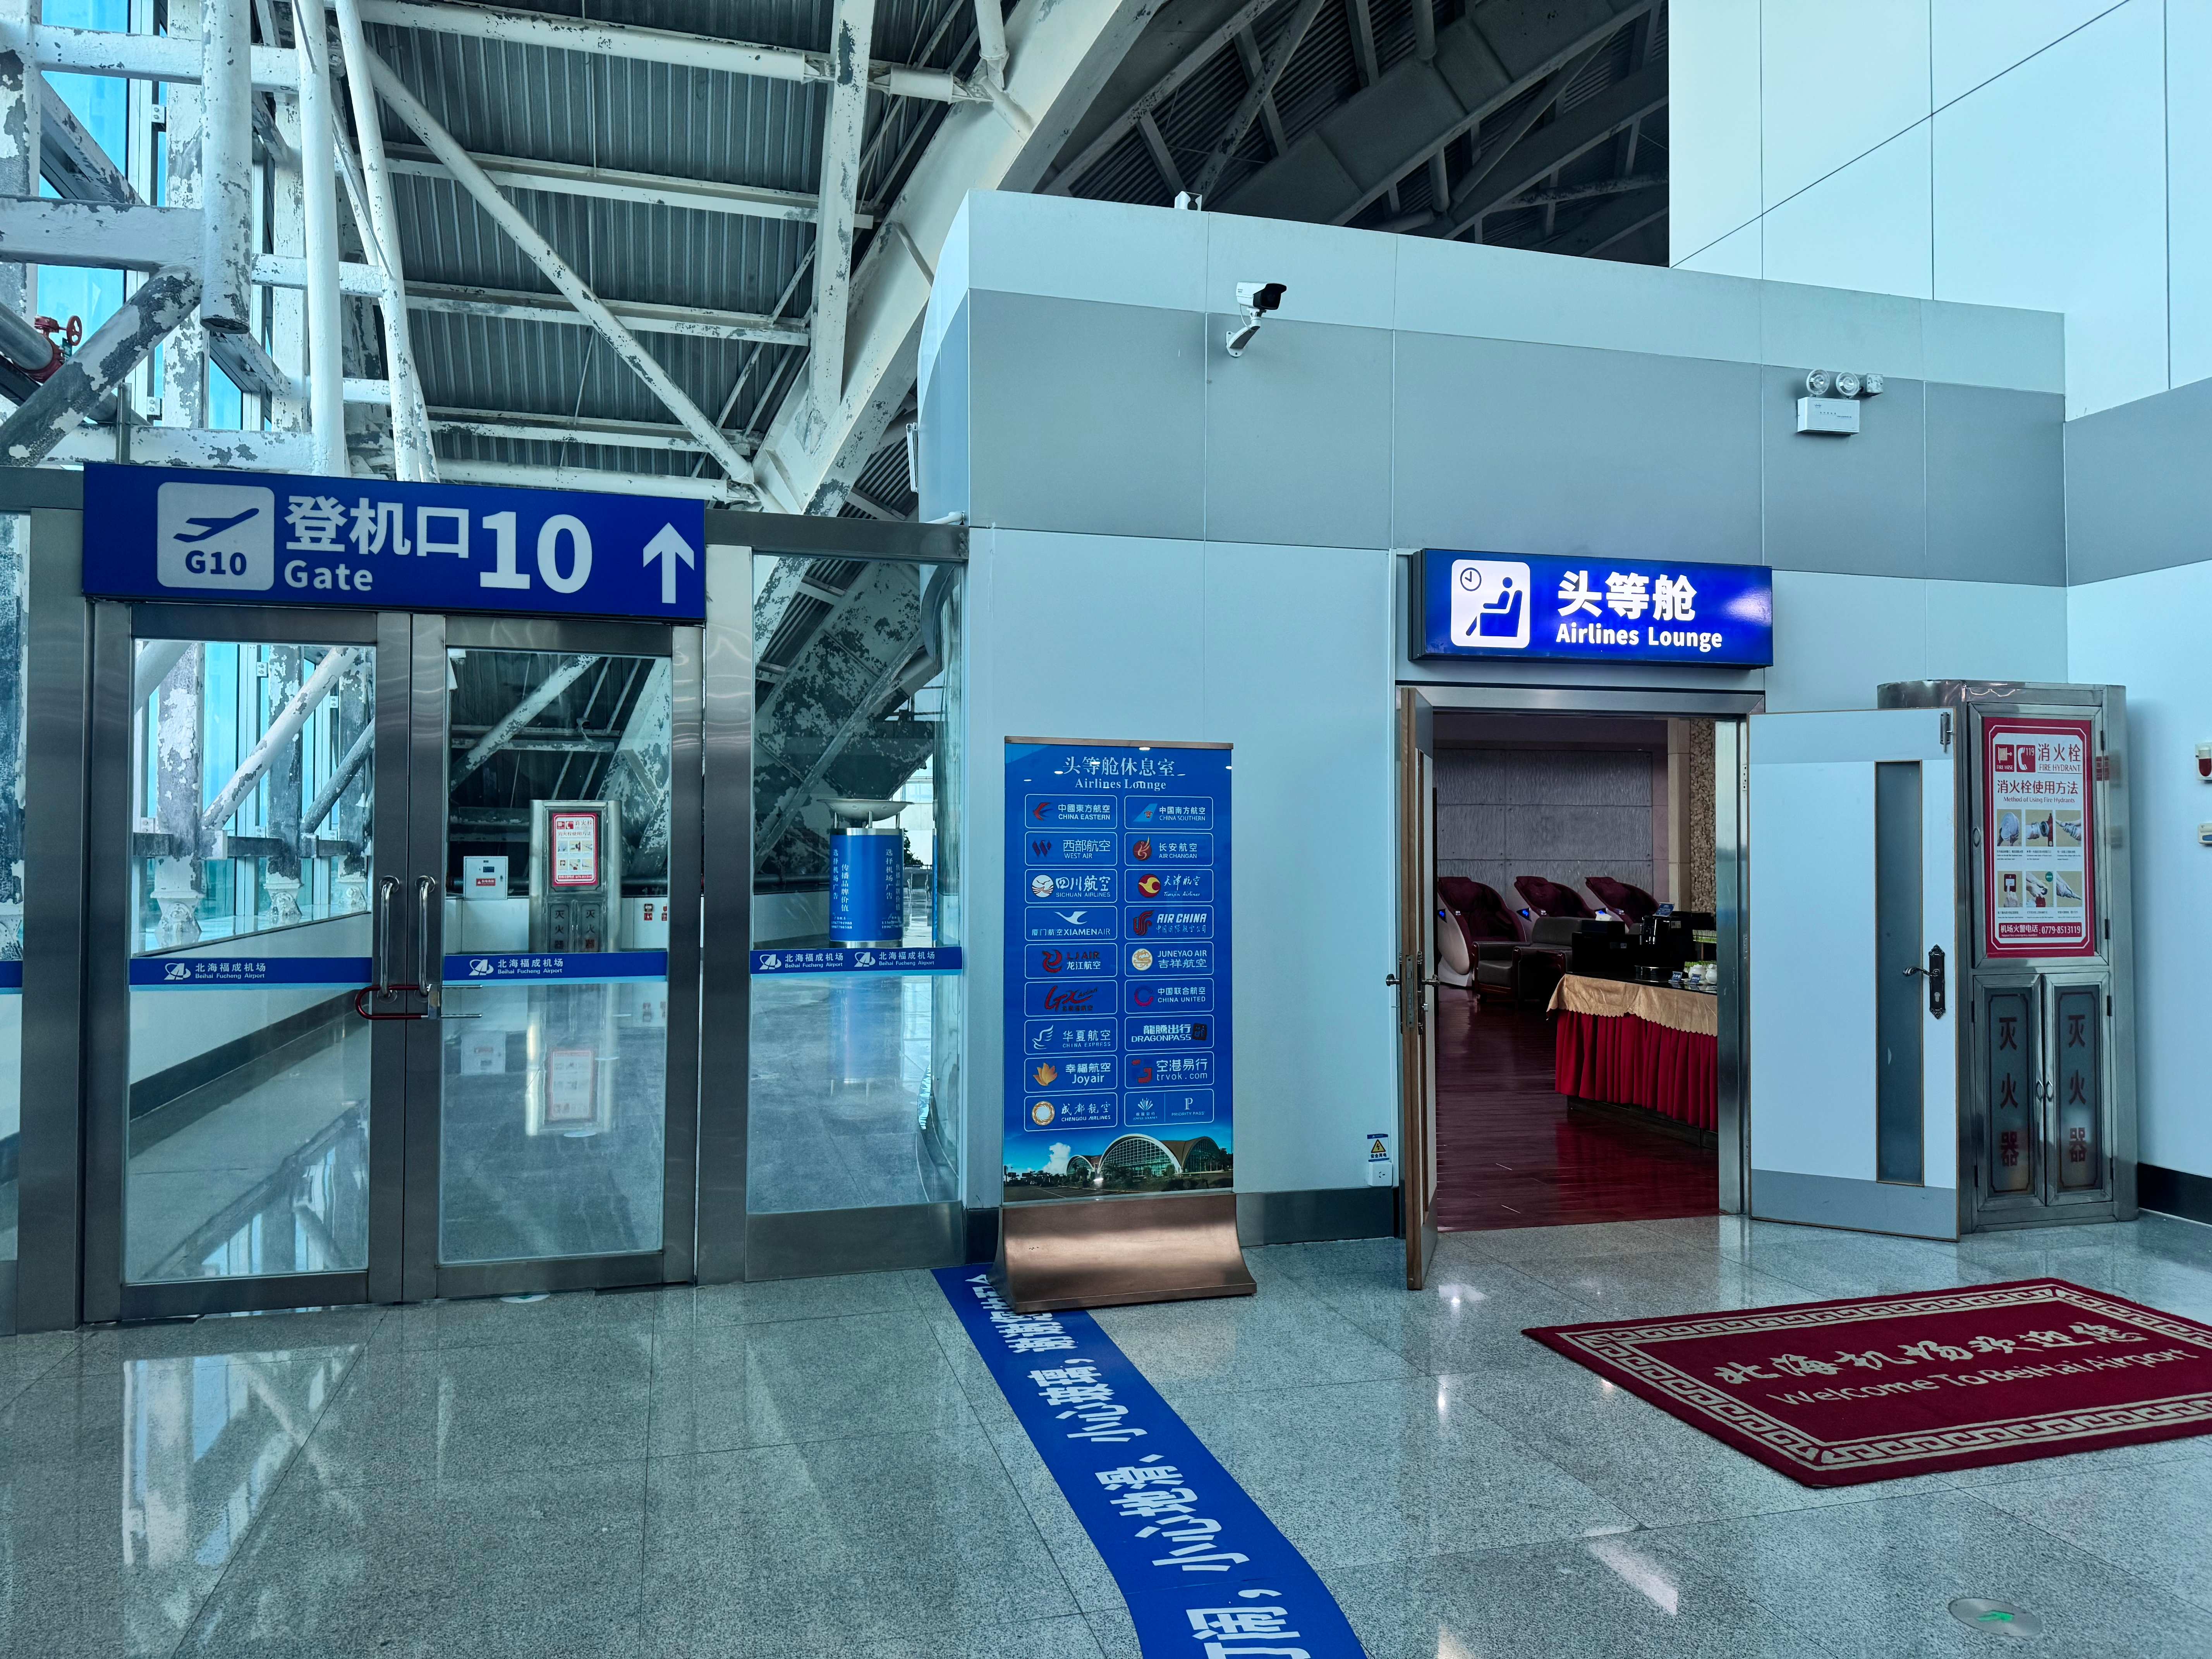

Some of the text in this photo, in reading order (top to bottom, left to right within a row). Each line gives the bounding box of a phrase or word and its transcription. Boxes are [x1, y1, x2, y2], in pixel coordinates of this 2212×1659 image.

[285, 495, 592, 594] 登机口 10
[185, 550, 247, 575] G10
[284, 560, 373, 591] Gate
[1557, 570, 1697, 621] 头等舱
[1556, 623, 1723, 652] Airlines Lounge
[2026, 747, 2034, 756] 119
[2038, 743, 2081, 762] 消火栓
[1063, 756, 1175, 776] 头等舱休息室
[1075, 778, 1166, 791] Airlines Lounge
[1997, 780, 2078, 794] 消火栓使用方法
[1159, 806, 1206, 815] 中国南方航空
[1063, 840, 1111, 852] 西部航空
[1159, 843, 1197, 852] 长安航空
[1056, 875, 1111, 892] 四川航空
[1164, 874, 1200, 891] 天津航空
[1157, 913, 1207, 923] AIR CHINA
[785, 953, 844, 963] 北海福成机场
[879, 951, 935, 960] 北海福成机场
[195, 962, 266, 972] 北海福成机场
[498, 958, 563, 968] 北海福成机场
[1066, 961, 1101, 970] 龙江航空
[1159, 958, 1207, 968] 吉祥航空
[1158, 987, 1206, 996] 中国联合航空
[1063, 1029, 1111, 1041] 华夏航空
[1065, 1062, 1111, 1073] 幸福航空
[1156, 1059, 1207, 1072] 空港易行
[1072, 1074, 1104, 1085] Joyair
[1999, 1017, 2018, 1167] 灭火器
[2068, 1014, 2087, 1162] 灭火器
[1766, 1379, 1940, 1405] Welcome
[1928, 1370, 1989, 1387] To
[2089, 1348, 2200, 1371] Airport
